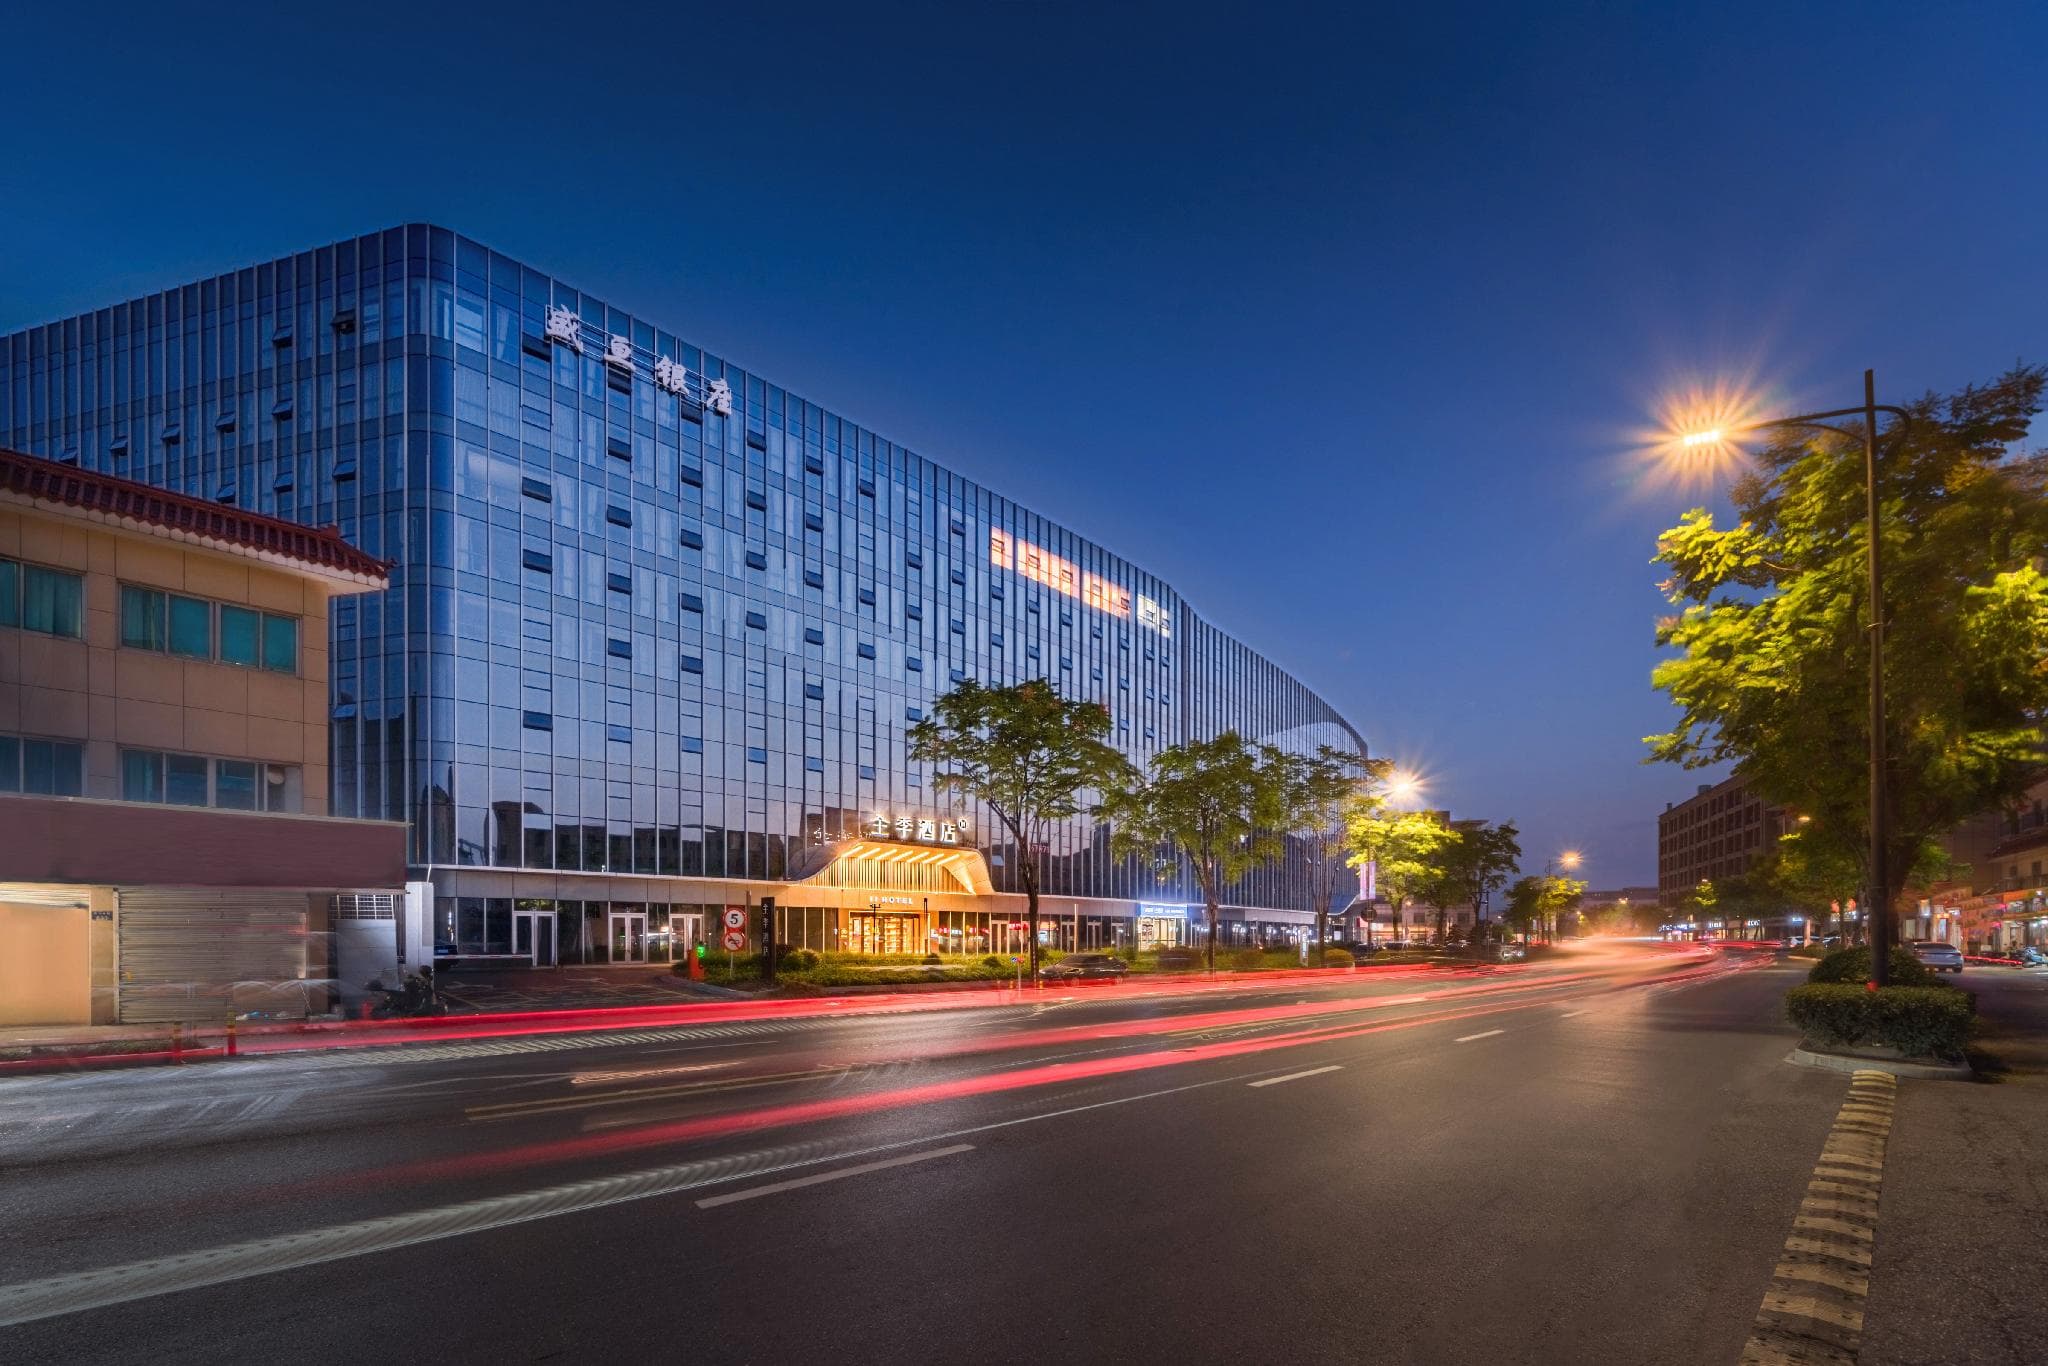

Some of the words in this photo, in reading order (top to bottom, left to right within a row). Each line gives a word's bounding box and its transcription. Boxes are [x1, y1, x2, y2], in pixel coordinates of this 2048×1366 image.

[870, 814, 957, 842] 全季酒店
[881, 896, 913, 905] HOTEL
[729, 913, 739, 925] 5
